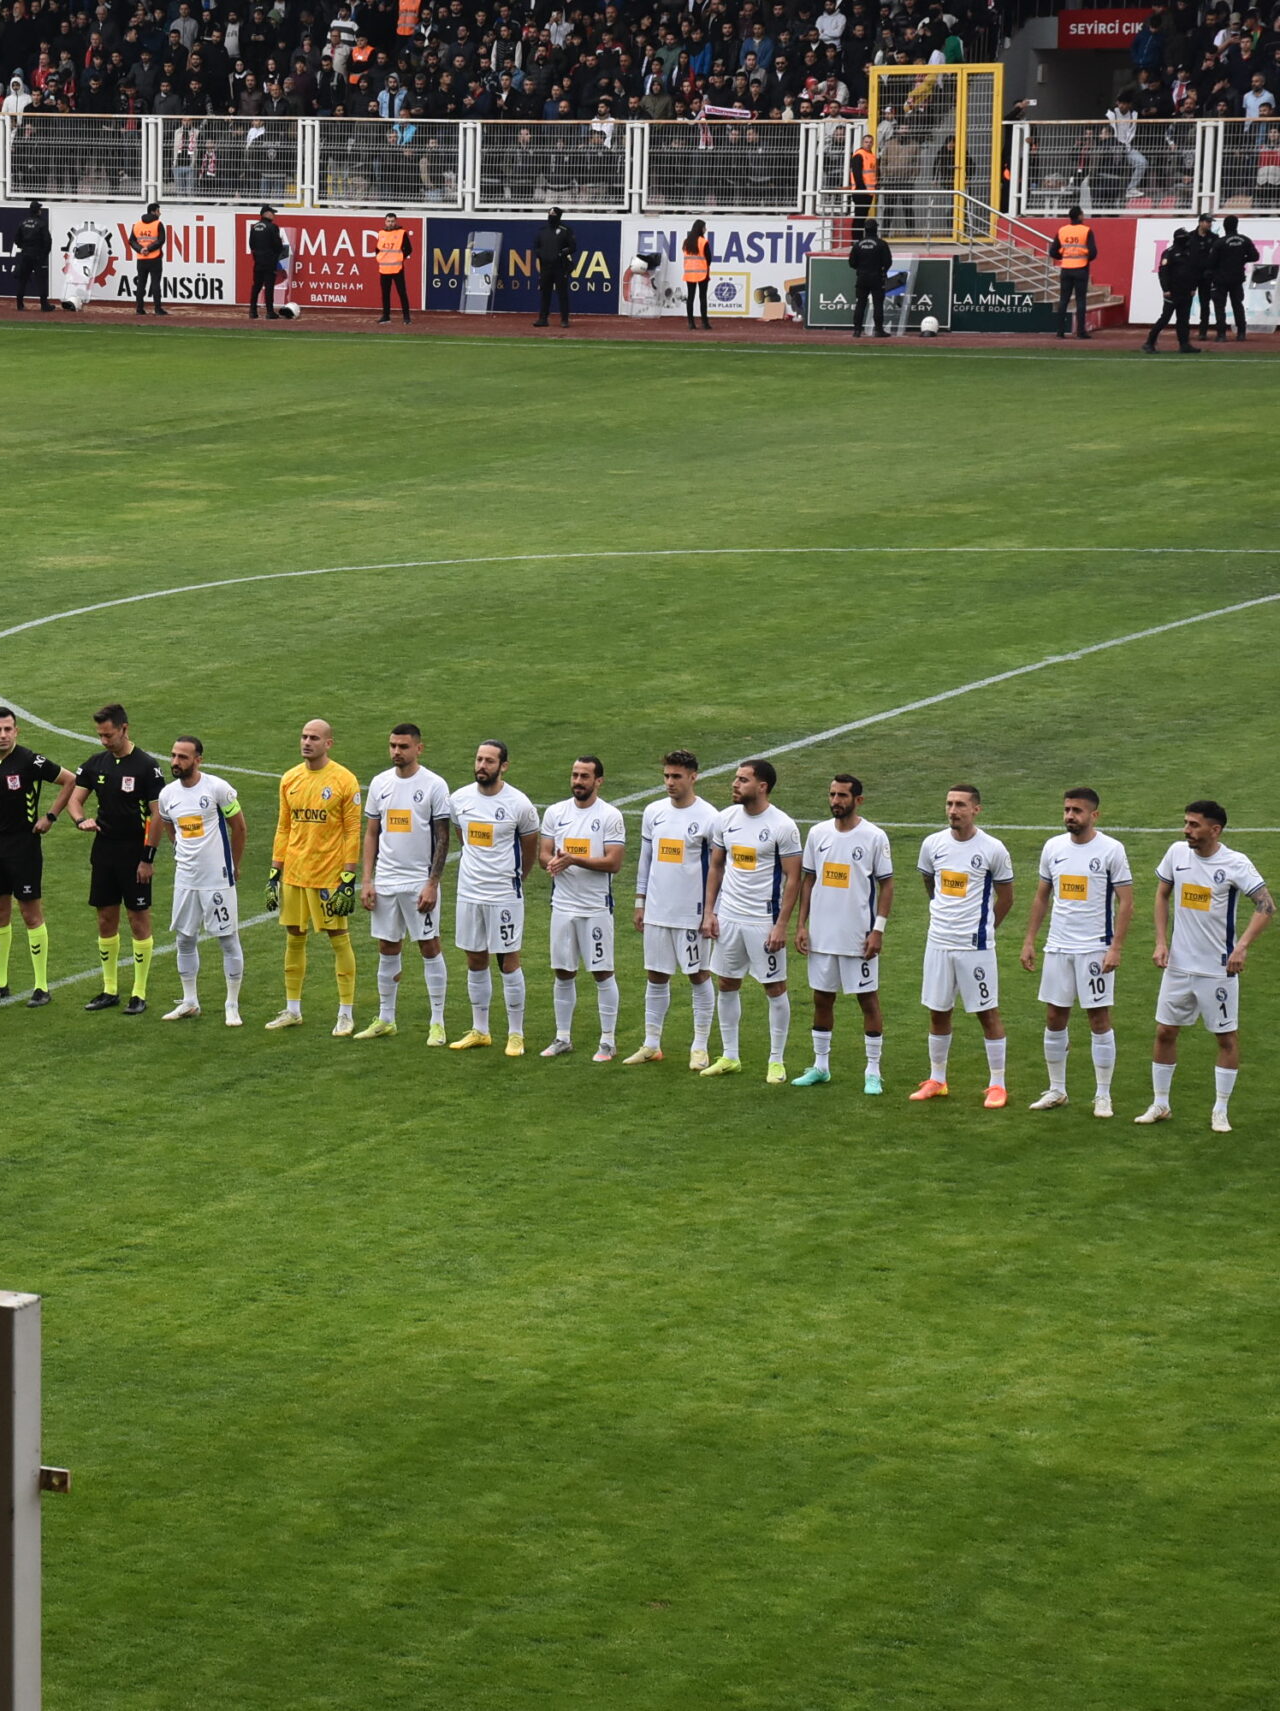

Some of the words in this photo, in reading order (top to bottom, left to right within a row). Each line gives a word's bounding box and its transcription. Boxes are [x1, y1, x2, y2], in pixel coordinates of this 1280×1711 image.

[1068, 19, 1119, 35] SEYİRCİ
[1122, 21, 1144, 36] ÇIK
[637, 230, 677, 263] EN
[687, 225, 817, 264] LASTİK
[295, 261, 360, 276] PLAZA
[291, 281, 304, 289] BY
[309, 281, 364, 291] WYNDHAM
[310, 293, 347, 303] BATMAN
[819, 293, 848, 304] LA
[953, 293, 974, 305] LA
[978, 294, 1033, 306] MINITA
[953, 305, 985, 313] COFFEE
[988, 305, 1033, 314] ROASTERY
[213, 907, 230, 922] 13
[424, 912, 433, 928] 4
[500, 924, 515, 940] 57
[595, 942, 603, 958] 5
[686, 944, 699, 961] 11
[768, 955, 777, 972] 9
[861, 962, 870, 978] 6
[978, 982, 989, 999] 8
[1088, 977, 1106, 995] 10
[1219, 1003, 1227, 1019] 1
